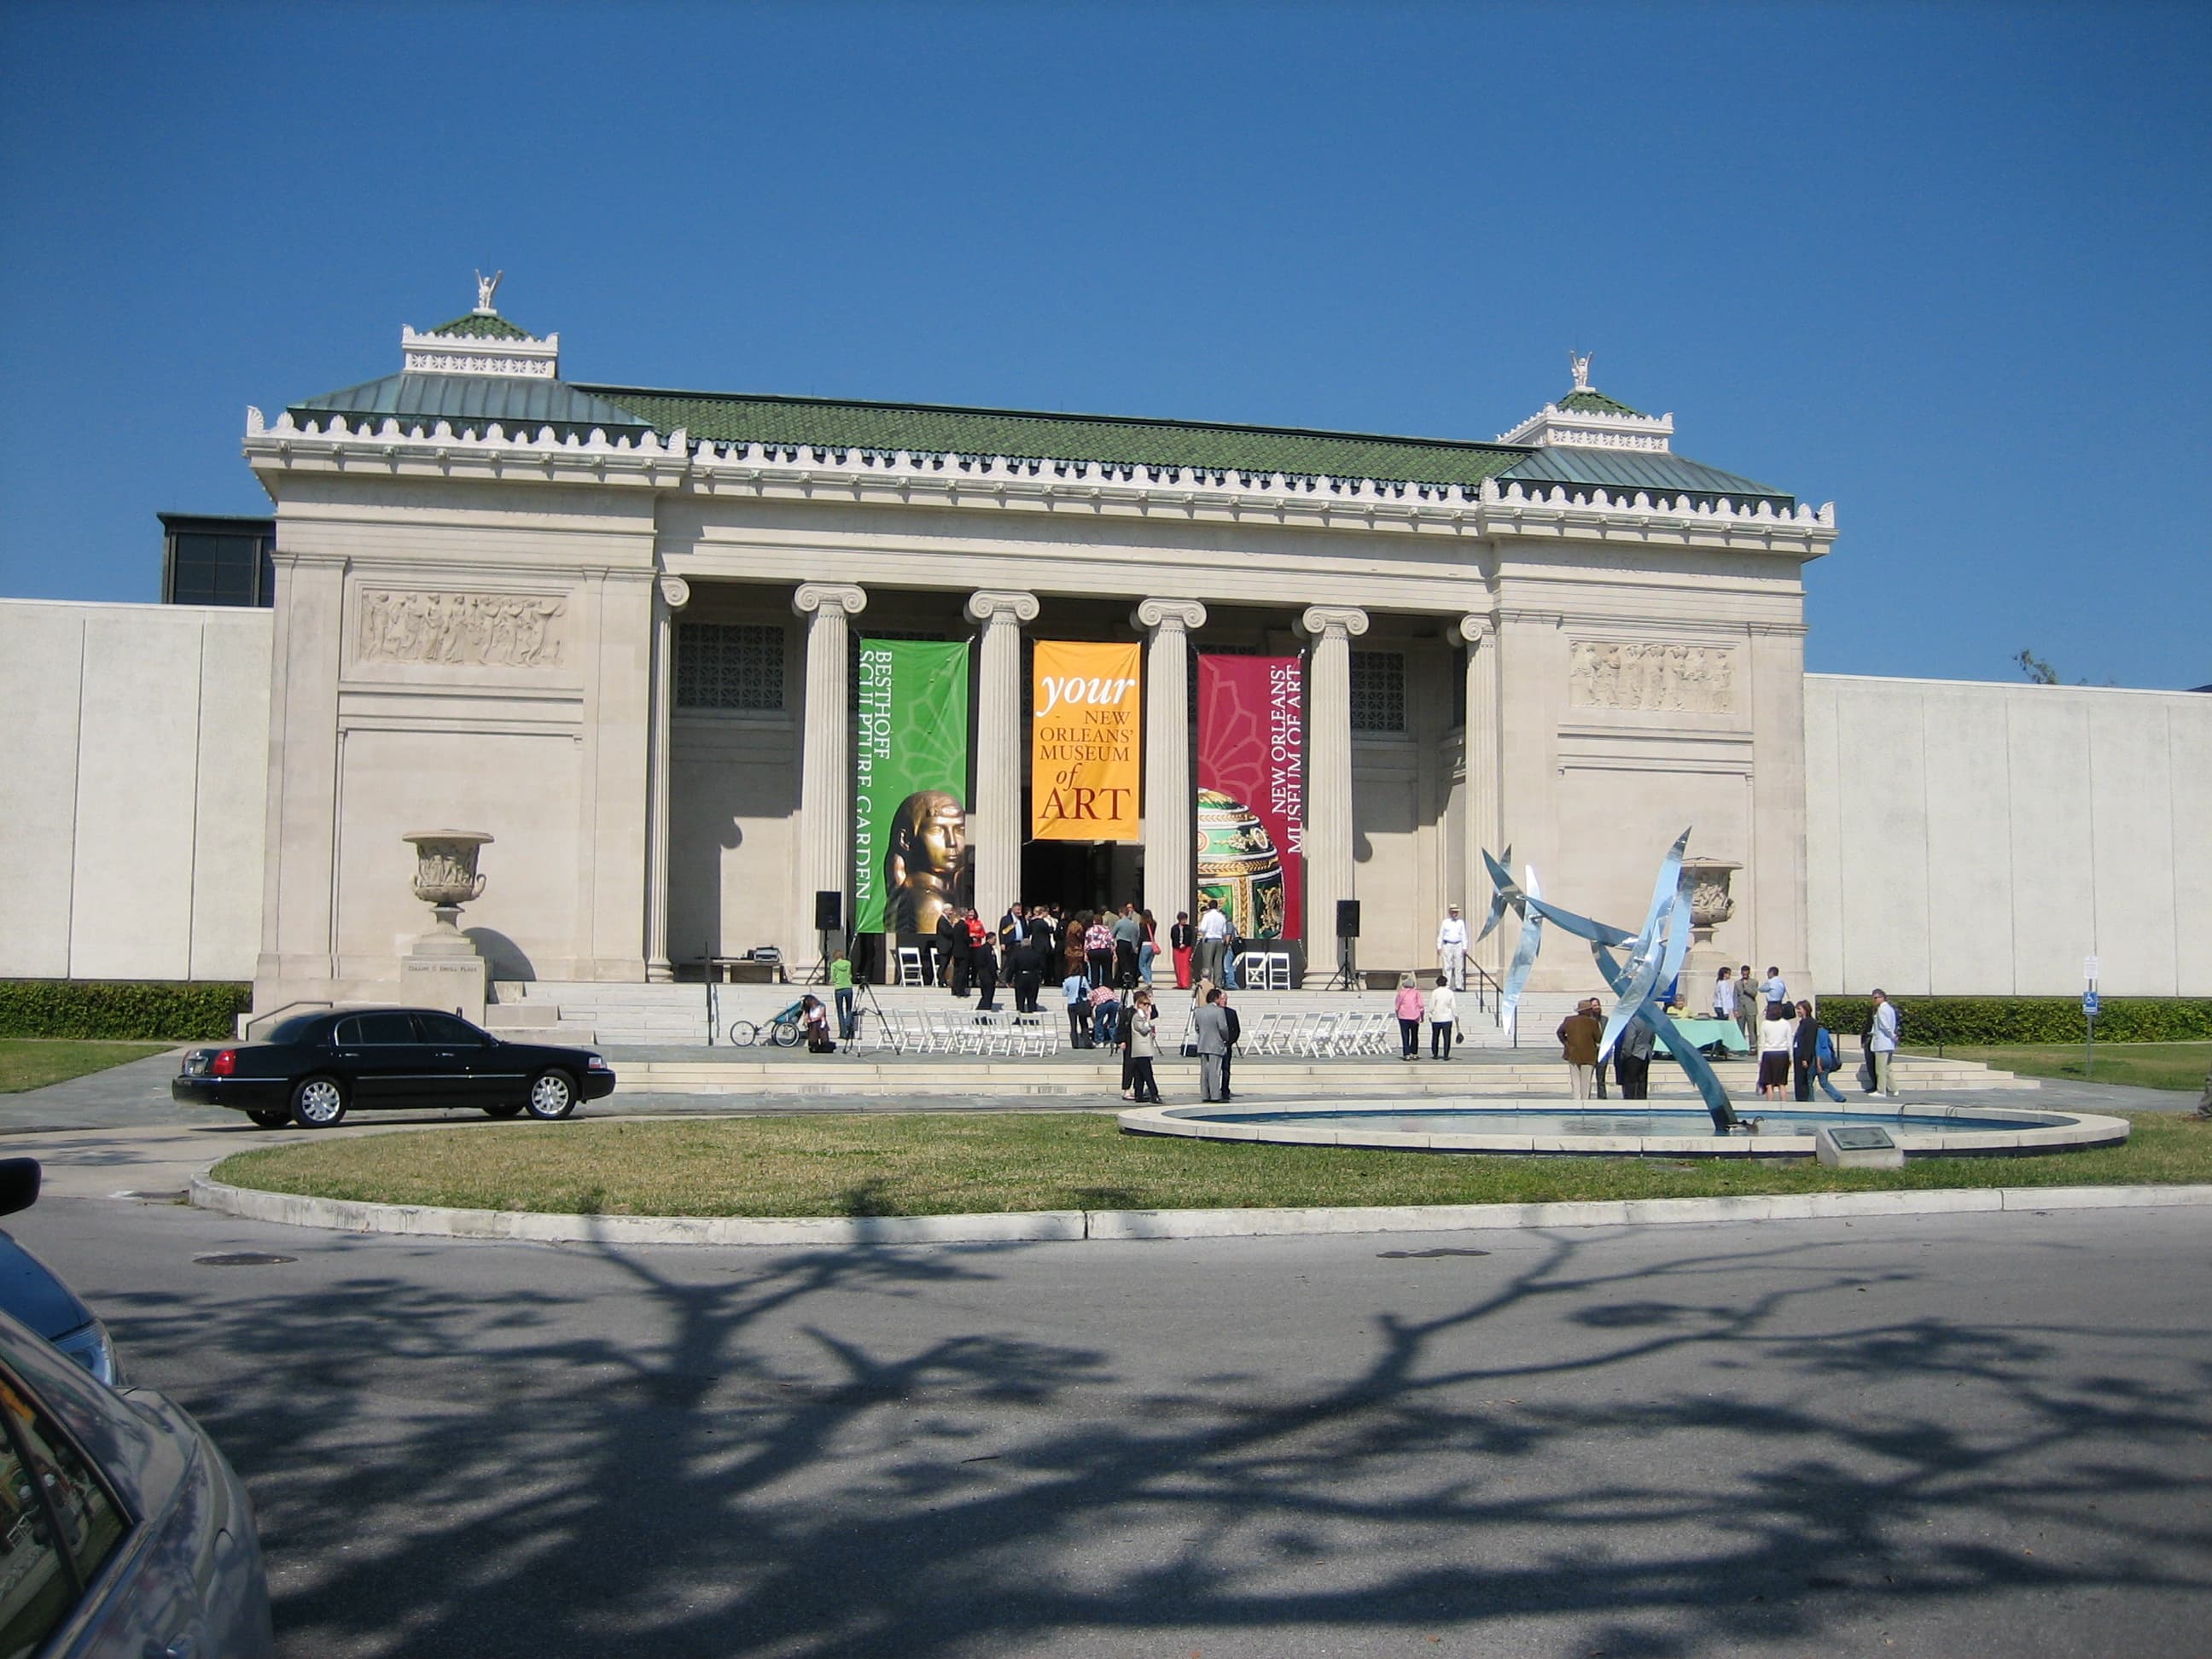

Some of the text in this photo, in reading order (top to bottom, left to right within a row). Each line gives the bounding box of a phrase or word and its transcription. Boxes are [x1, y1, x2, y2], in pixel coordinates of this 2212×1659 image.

[873, 650, 893, 760] BESTHOFF
[1035, 675, 1136, 718] your
[1039, 727, 1133, 743] ORLEANS'
[1085, 710, 1131, 725] NEW
[1039, 745, 1130, 761] MUSEUM
[1270, 665, 1287, 814] NEW ORLEANS'
[1287, 664, 1302, 854] MUSEUM OF ART
[855, 649, 875, 900] SCULPTURE GARDEN
[1056, 762, 1082, 792] of
[1038, 786, 1131, 821] ART
